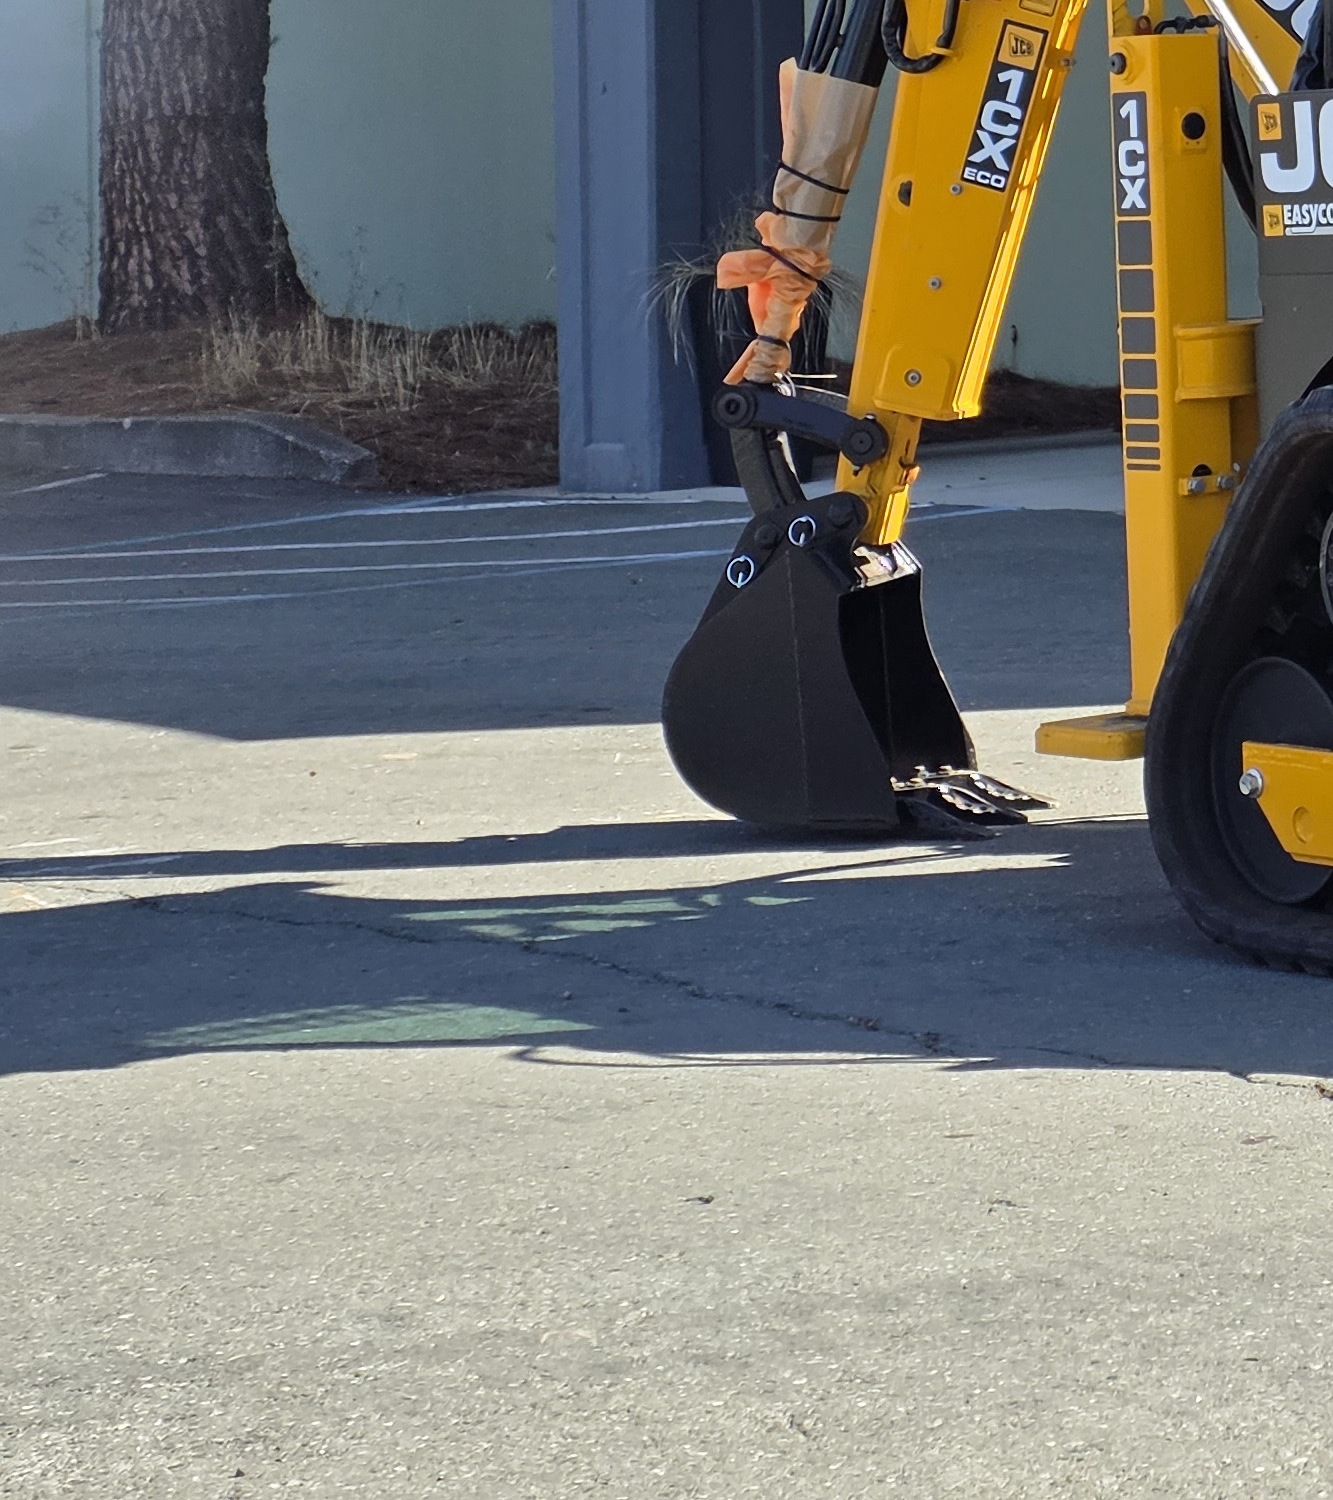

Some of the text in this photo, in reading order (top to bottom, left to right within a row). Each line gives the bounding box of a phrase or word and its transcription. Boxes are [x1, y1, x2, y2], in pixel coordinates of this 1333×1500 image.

[967, 69, 1024, 171] 1CX
[1118, 99, 1147, 209] 1CX
[963, 167, 1006, 189] ECO
